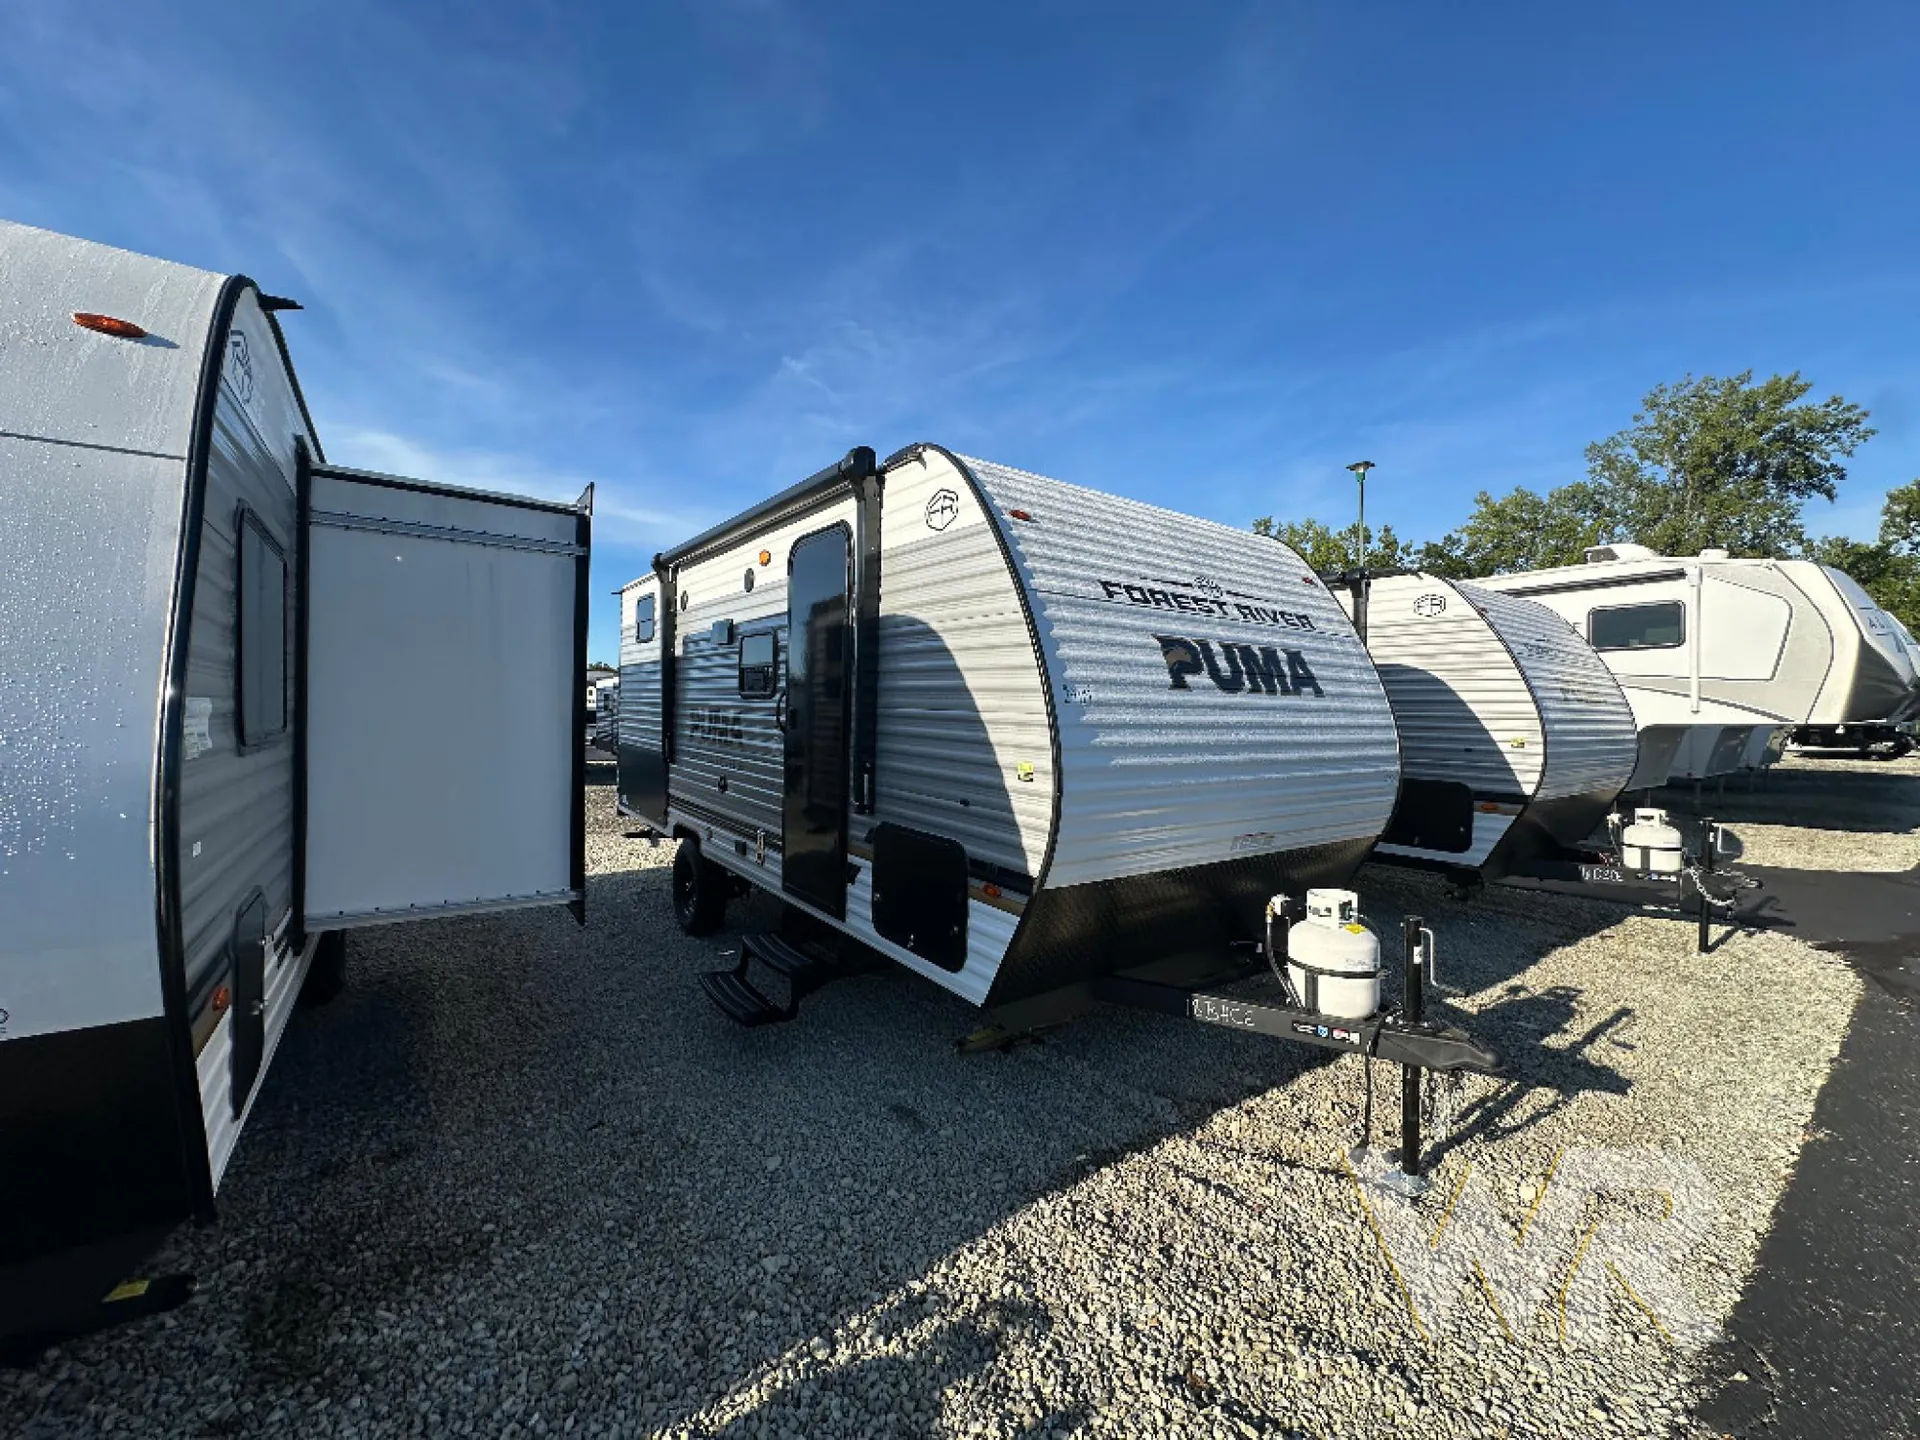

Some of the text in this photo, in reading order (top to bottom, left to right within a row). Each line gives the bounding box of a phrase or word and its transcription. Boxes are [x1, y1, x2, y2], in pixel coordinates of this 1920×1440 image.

[1097, 578, 1229, 617] FOREST
[1233, 603, 1316, 631] RIVER
[1151, 633, 1325, 698] PUMA
